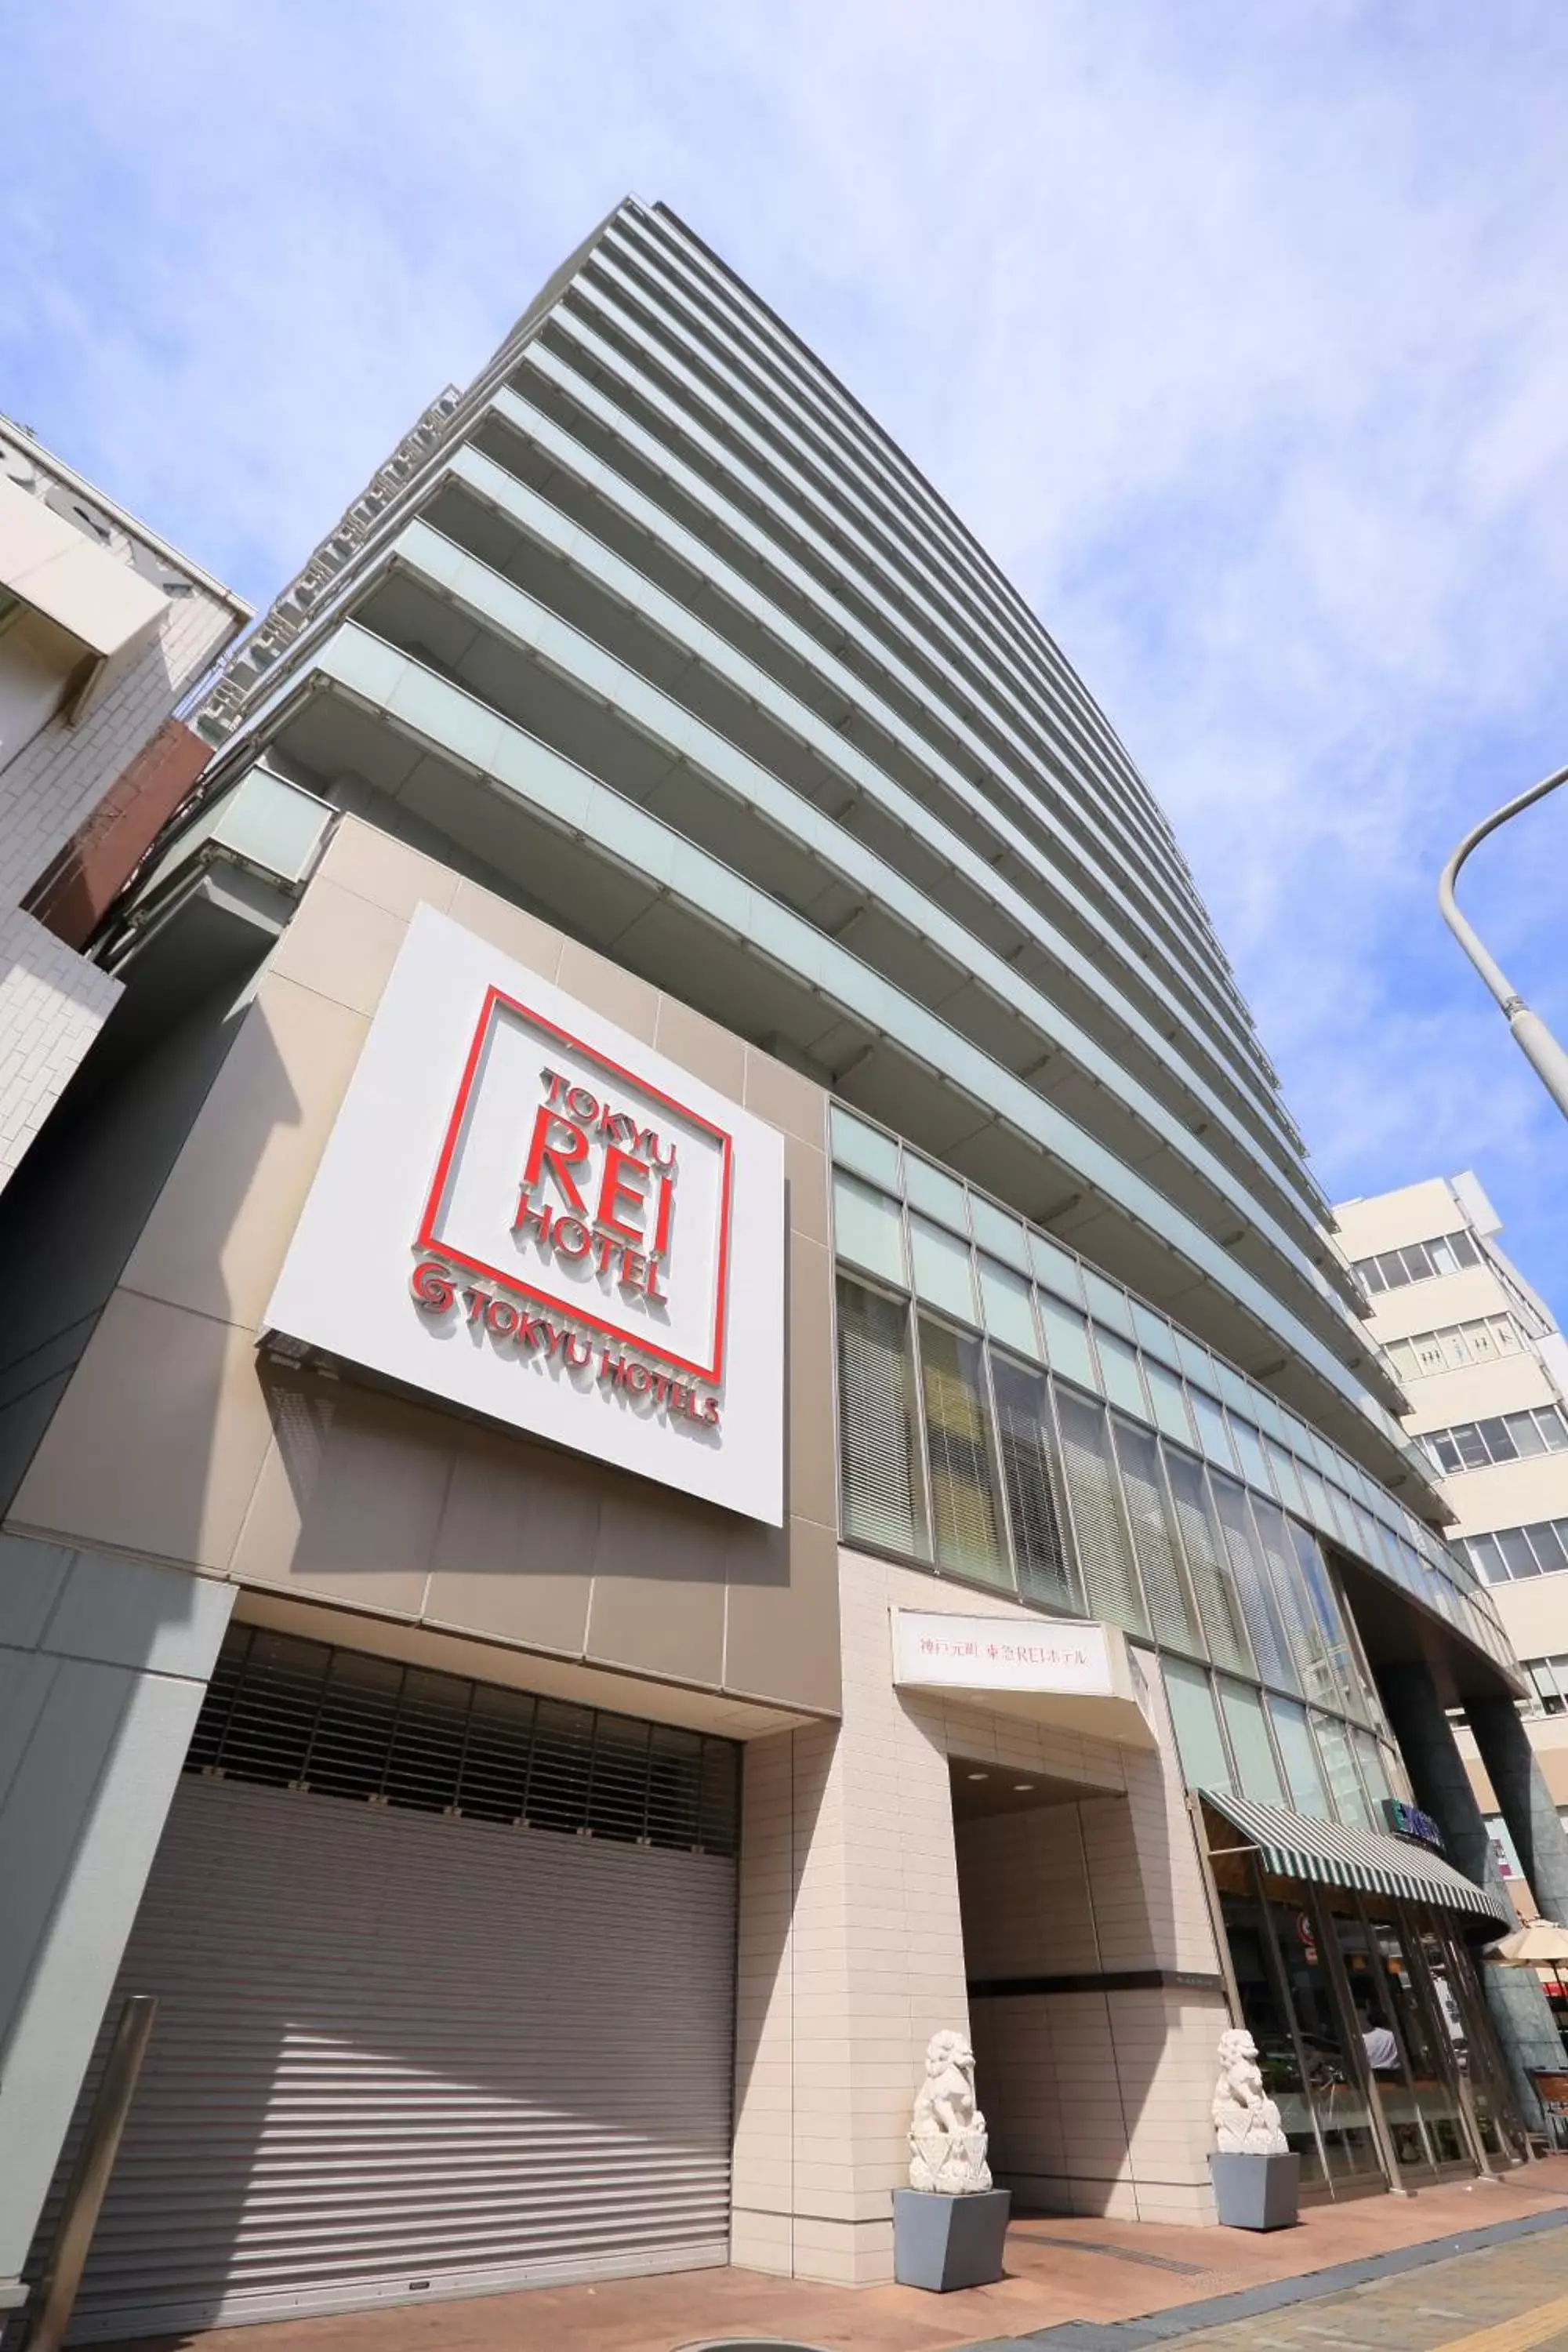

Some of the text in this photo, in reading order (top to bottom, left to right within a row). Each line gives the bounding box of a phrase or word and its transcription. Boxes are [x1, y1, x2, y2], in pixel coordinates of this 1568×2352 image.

[523, 1104, 672, 1254] REI
[540, 1067, 676, 1166] TOKYU
[511, 1190, 667, 1302] HOTEL
[464, 1287, 720, 1426] TOKYU HOTELS
